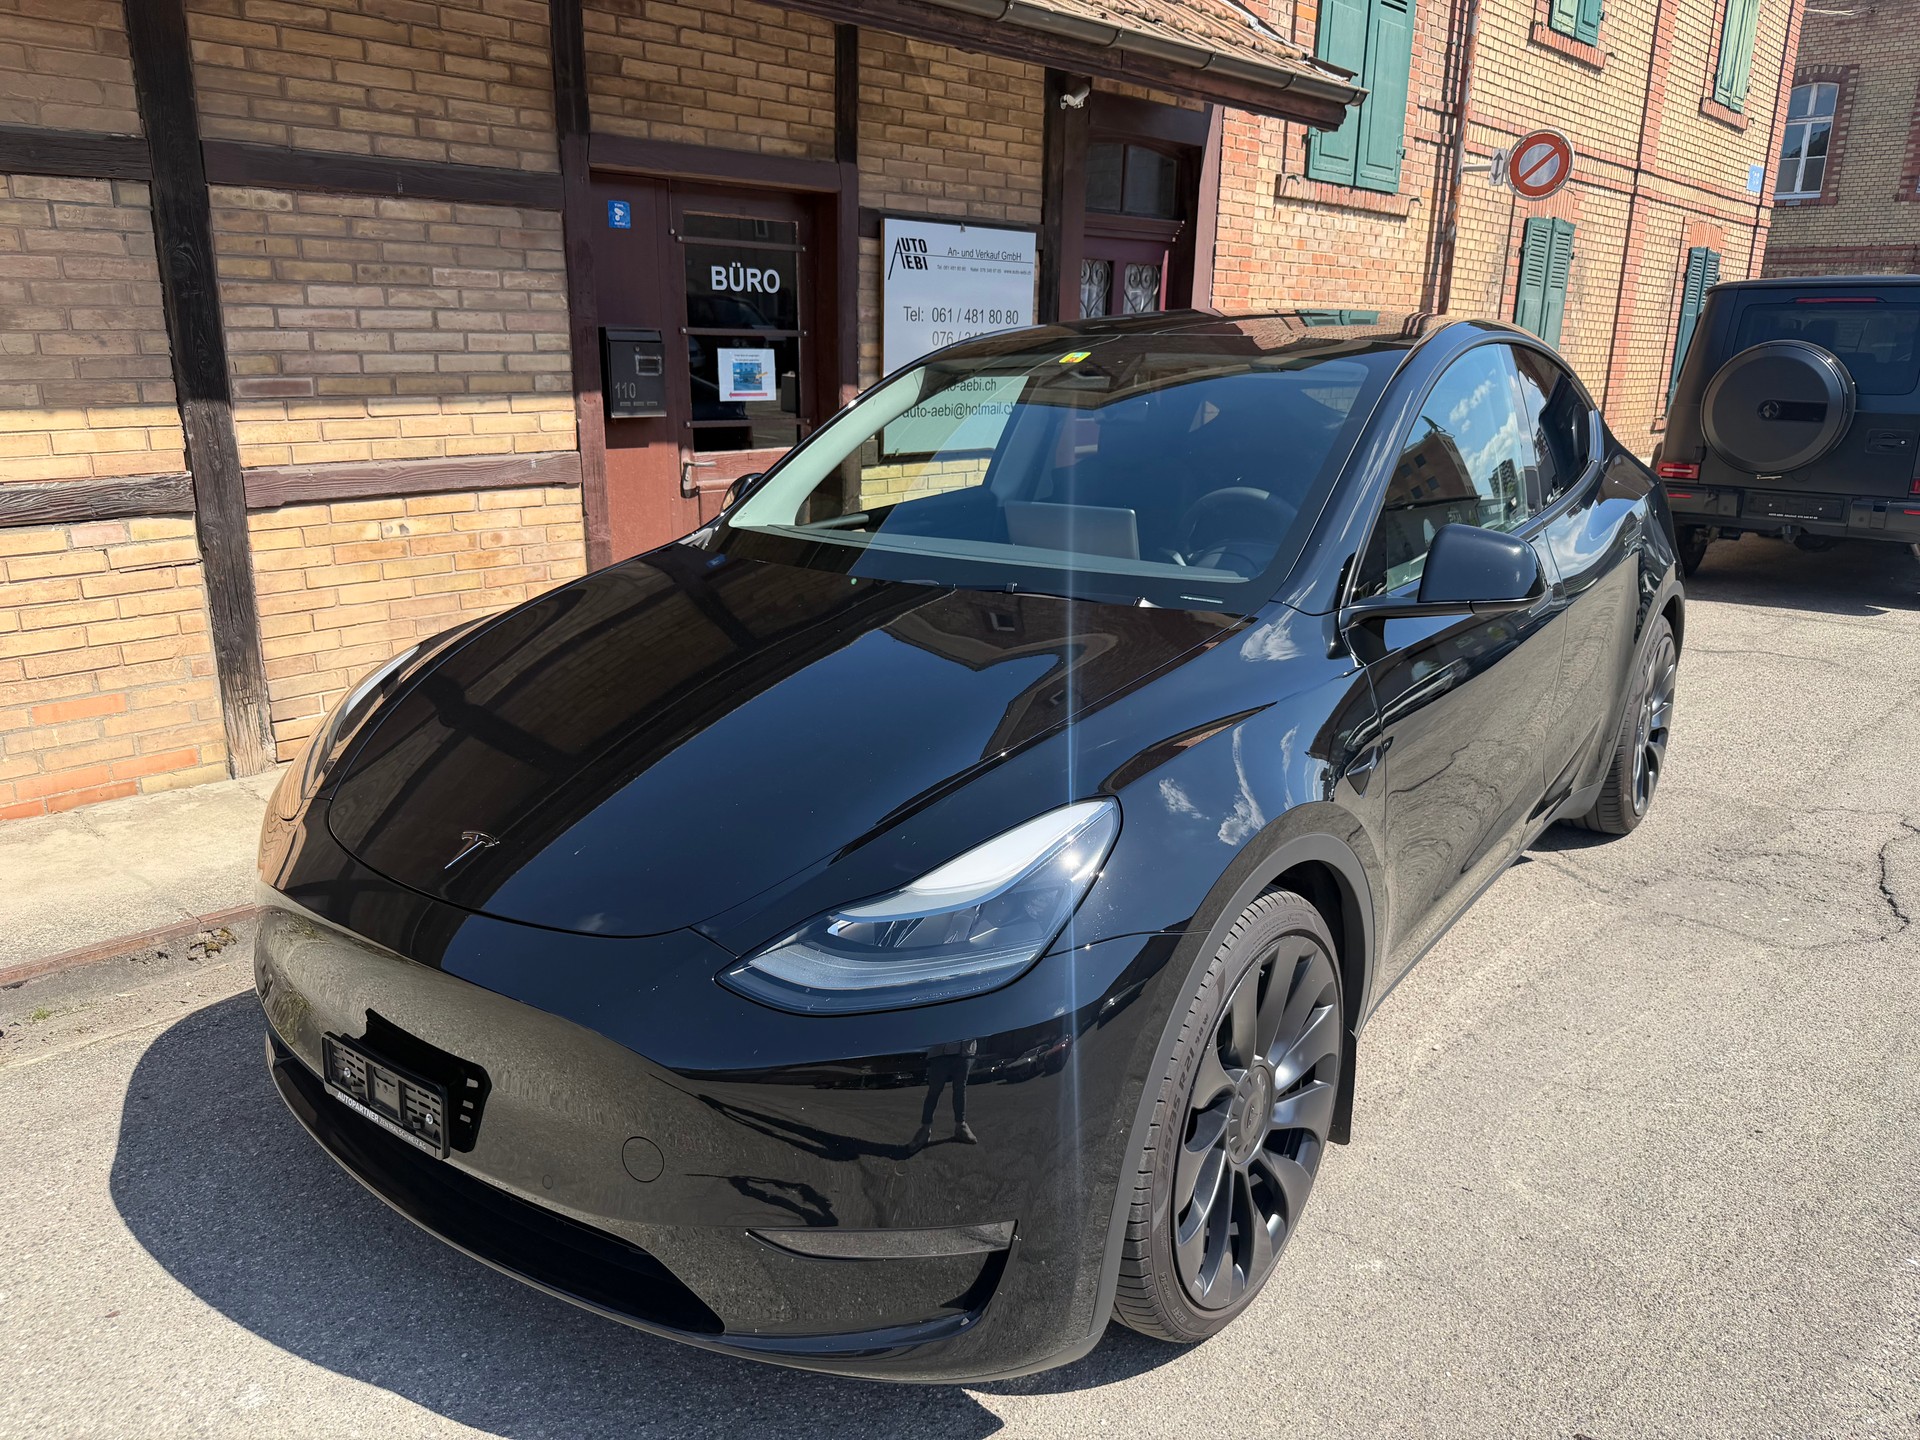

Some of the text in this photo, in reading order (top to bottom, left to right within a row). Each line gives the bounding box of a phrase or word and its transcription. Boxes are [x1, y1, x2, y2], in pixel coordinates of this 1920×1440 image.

[947, 247, 1022, 261] An- und Verkauf GmbH
[711, 262, 780, 293] BÜRO
[903, 306, 924, 322] Tel:
[931, 307, 952, 323] 061
[964, 308, 984, 324] 481
[988, 309, 1002, 324] 80
[1005, 310, 1019, 325] 80
[931, 331, 954, 346] 076
[615, 382, 636, 399] 110
[1178, 1047, 1195, 1091] R21
[337, 1091, 379, 1123] AUTOPARTNER
